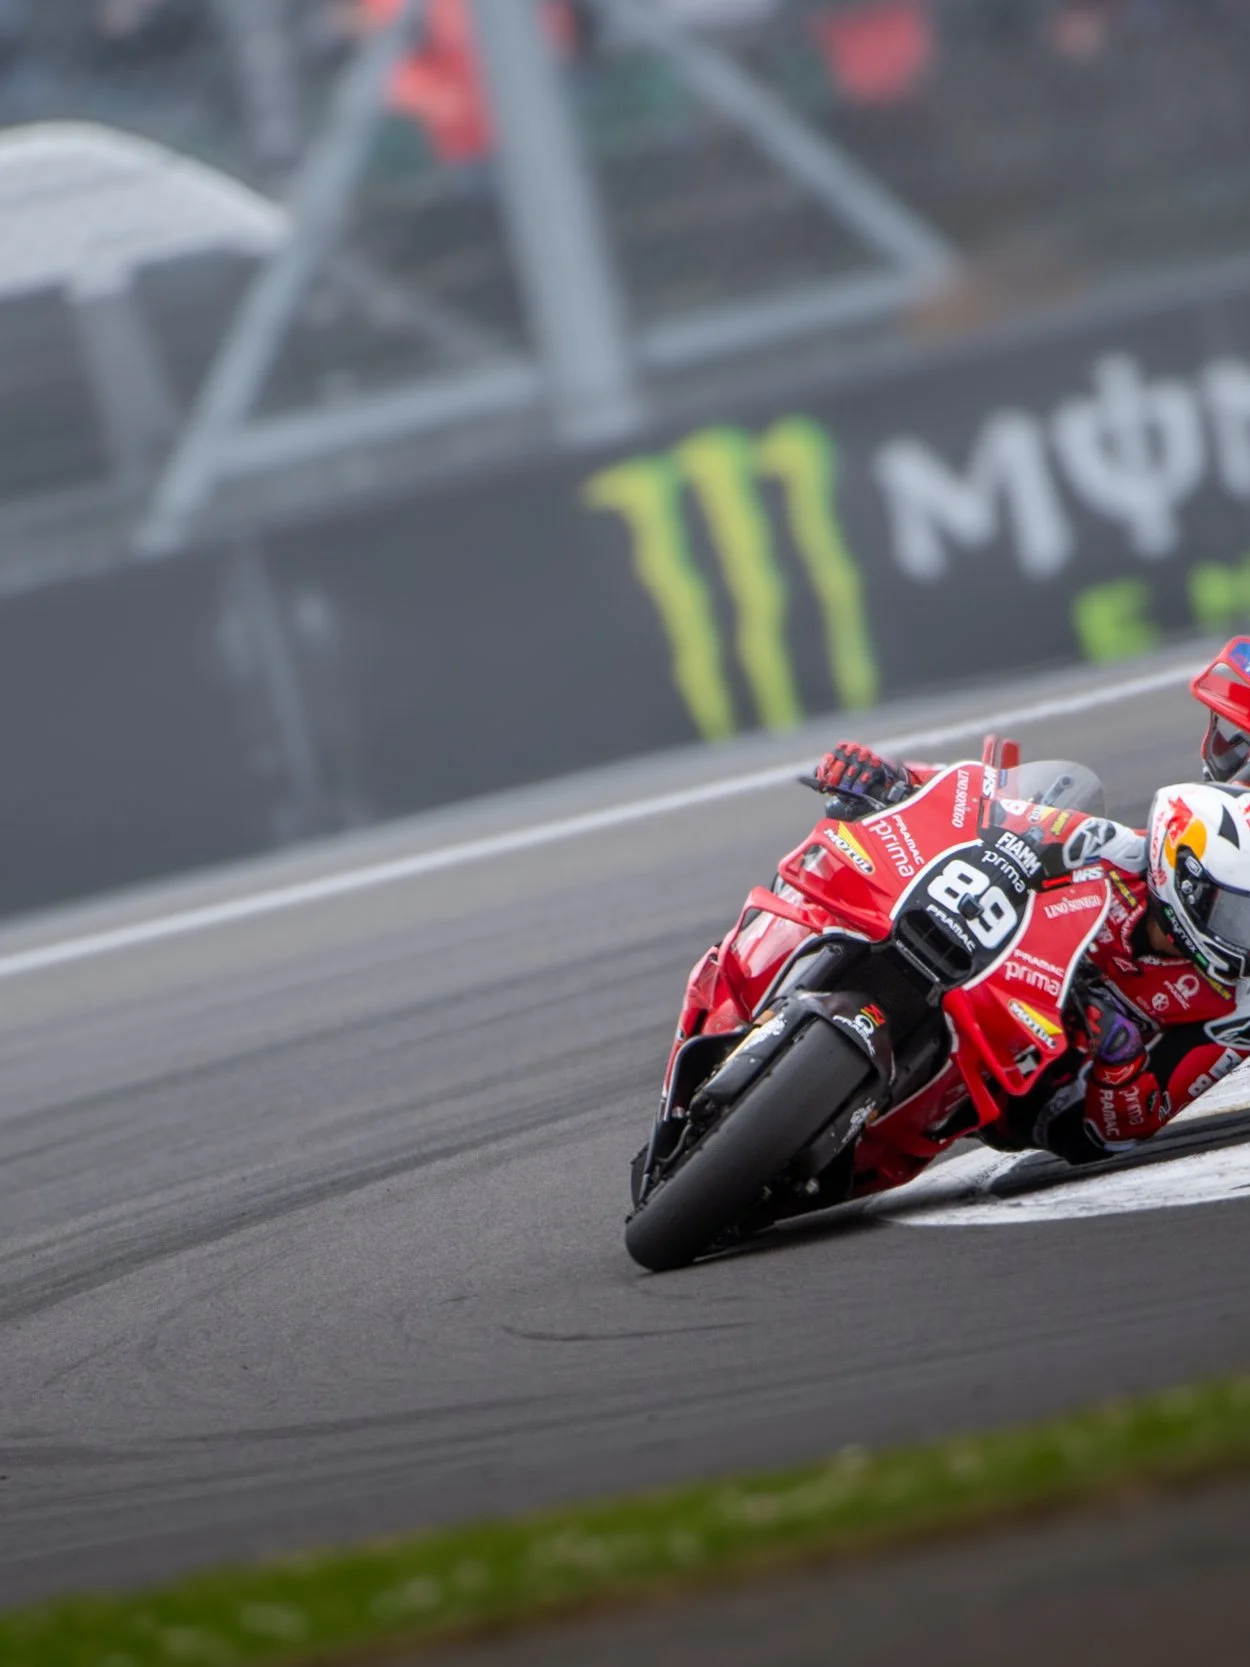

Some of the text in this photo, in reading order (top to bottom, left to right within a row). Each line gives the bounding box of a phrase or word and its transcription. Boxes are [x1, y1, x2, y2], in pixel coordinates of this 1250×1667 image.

[823, 828, 874, 874] MOTUL
[868, 820, 915, 878] prima
[892, 813, 925, 865] PRAMAC
[996, 831, 1042, 876] FIAMM
[981, 850, 1026, 893] prima
[927, 859, 1018, 950] 89
[926, 903, 976, 953] PRAMAC
[1004, 961, 1062, 997] prima
[1013, 949, 1065, 978] PRAMAC
